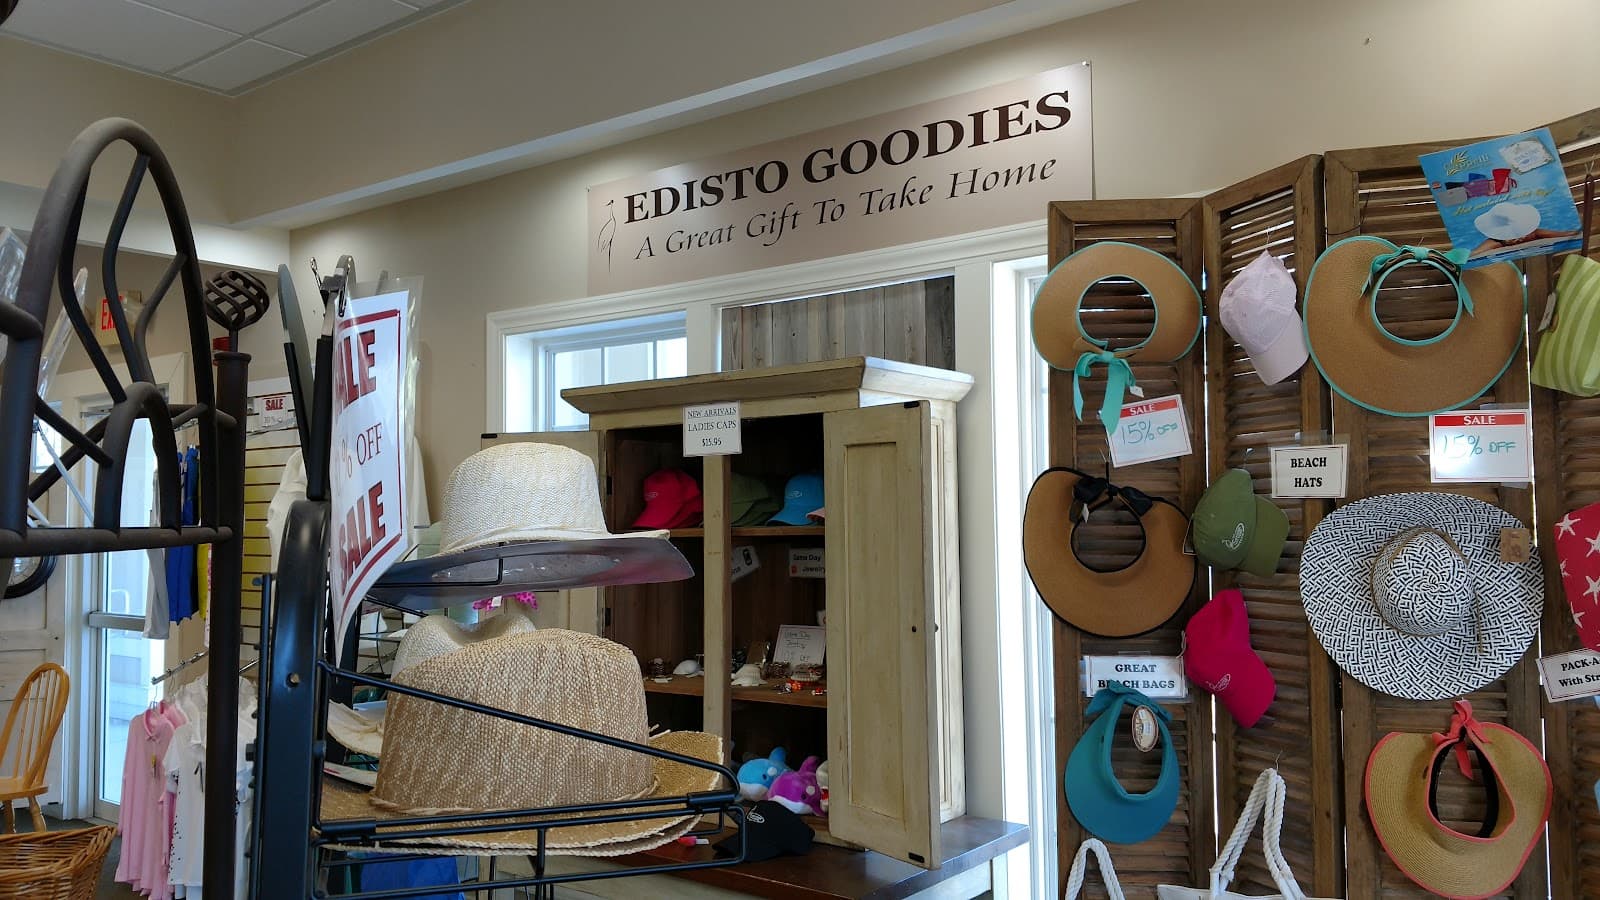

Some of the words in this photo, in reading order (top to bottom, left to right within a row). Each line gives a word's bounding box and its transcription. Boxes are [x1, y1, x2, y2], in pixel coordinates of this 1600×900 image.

[624, 160, 789, 224] EDISTO
[802, 90, 1072, 183] GOODIES
[634, 236, 656, 260] A
[666, 224, 736, 253] Great
[746, 202, 802, 247] Gift
[813, 198, 845, 226] To
[860, 175, 934, 216] Take
[946, 158, 1057, 200] Home
[336, 329, 377, 417] ALE
[265, 398, 284, 412] SALE
[1129, 403, 1156, 416] SALE
[687, 410, 702, 420] NEW
[703, 407, 737, 418] ARRIVALS
[1463, 415, 1497, 425] SALE
[688, 422, 715, 432] LADIES
[716, 420, 737, 430] CAPS
[1121, 419, 1155, 445] 15%
[356, 422, 383, 466] OFF
[1443, 434, 1483, 459] 15%
[1488, 441, 1517, 456] OFF
[1290, 457, 1327, 468] BEACH
[1294, 477, 1323, 488] HATS
[338, 480, 386, 596] SALE
[1114, 664, 1157, 673] GREAT
[1142, 680, 1175, 689] BAGS
[1558, 676, 1584, 687] With
